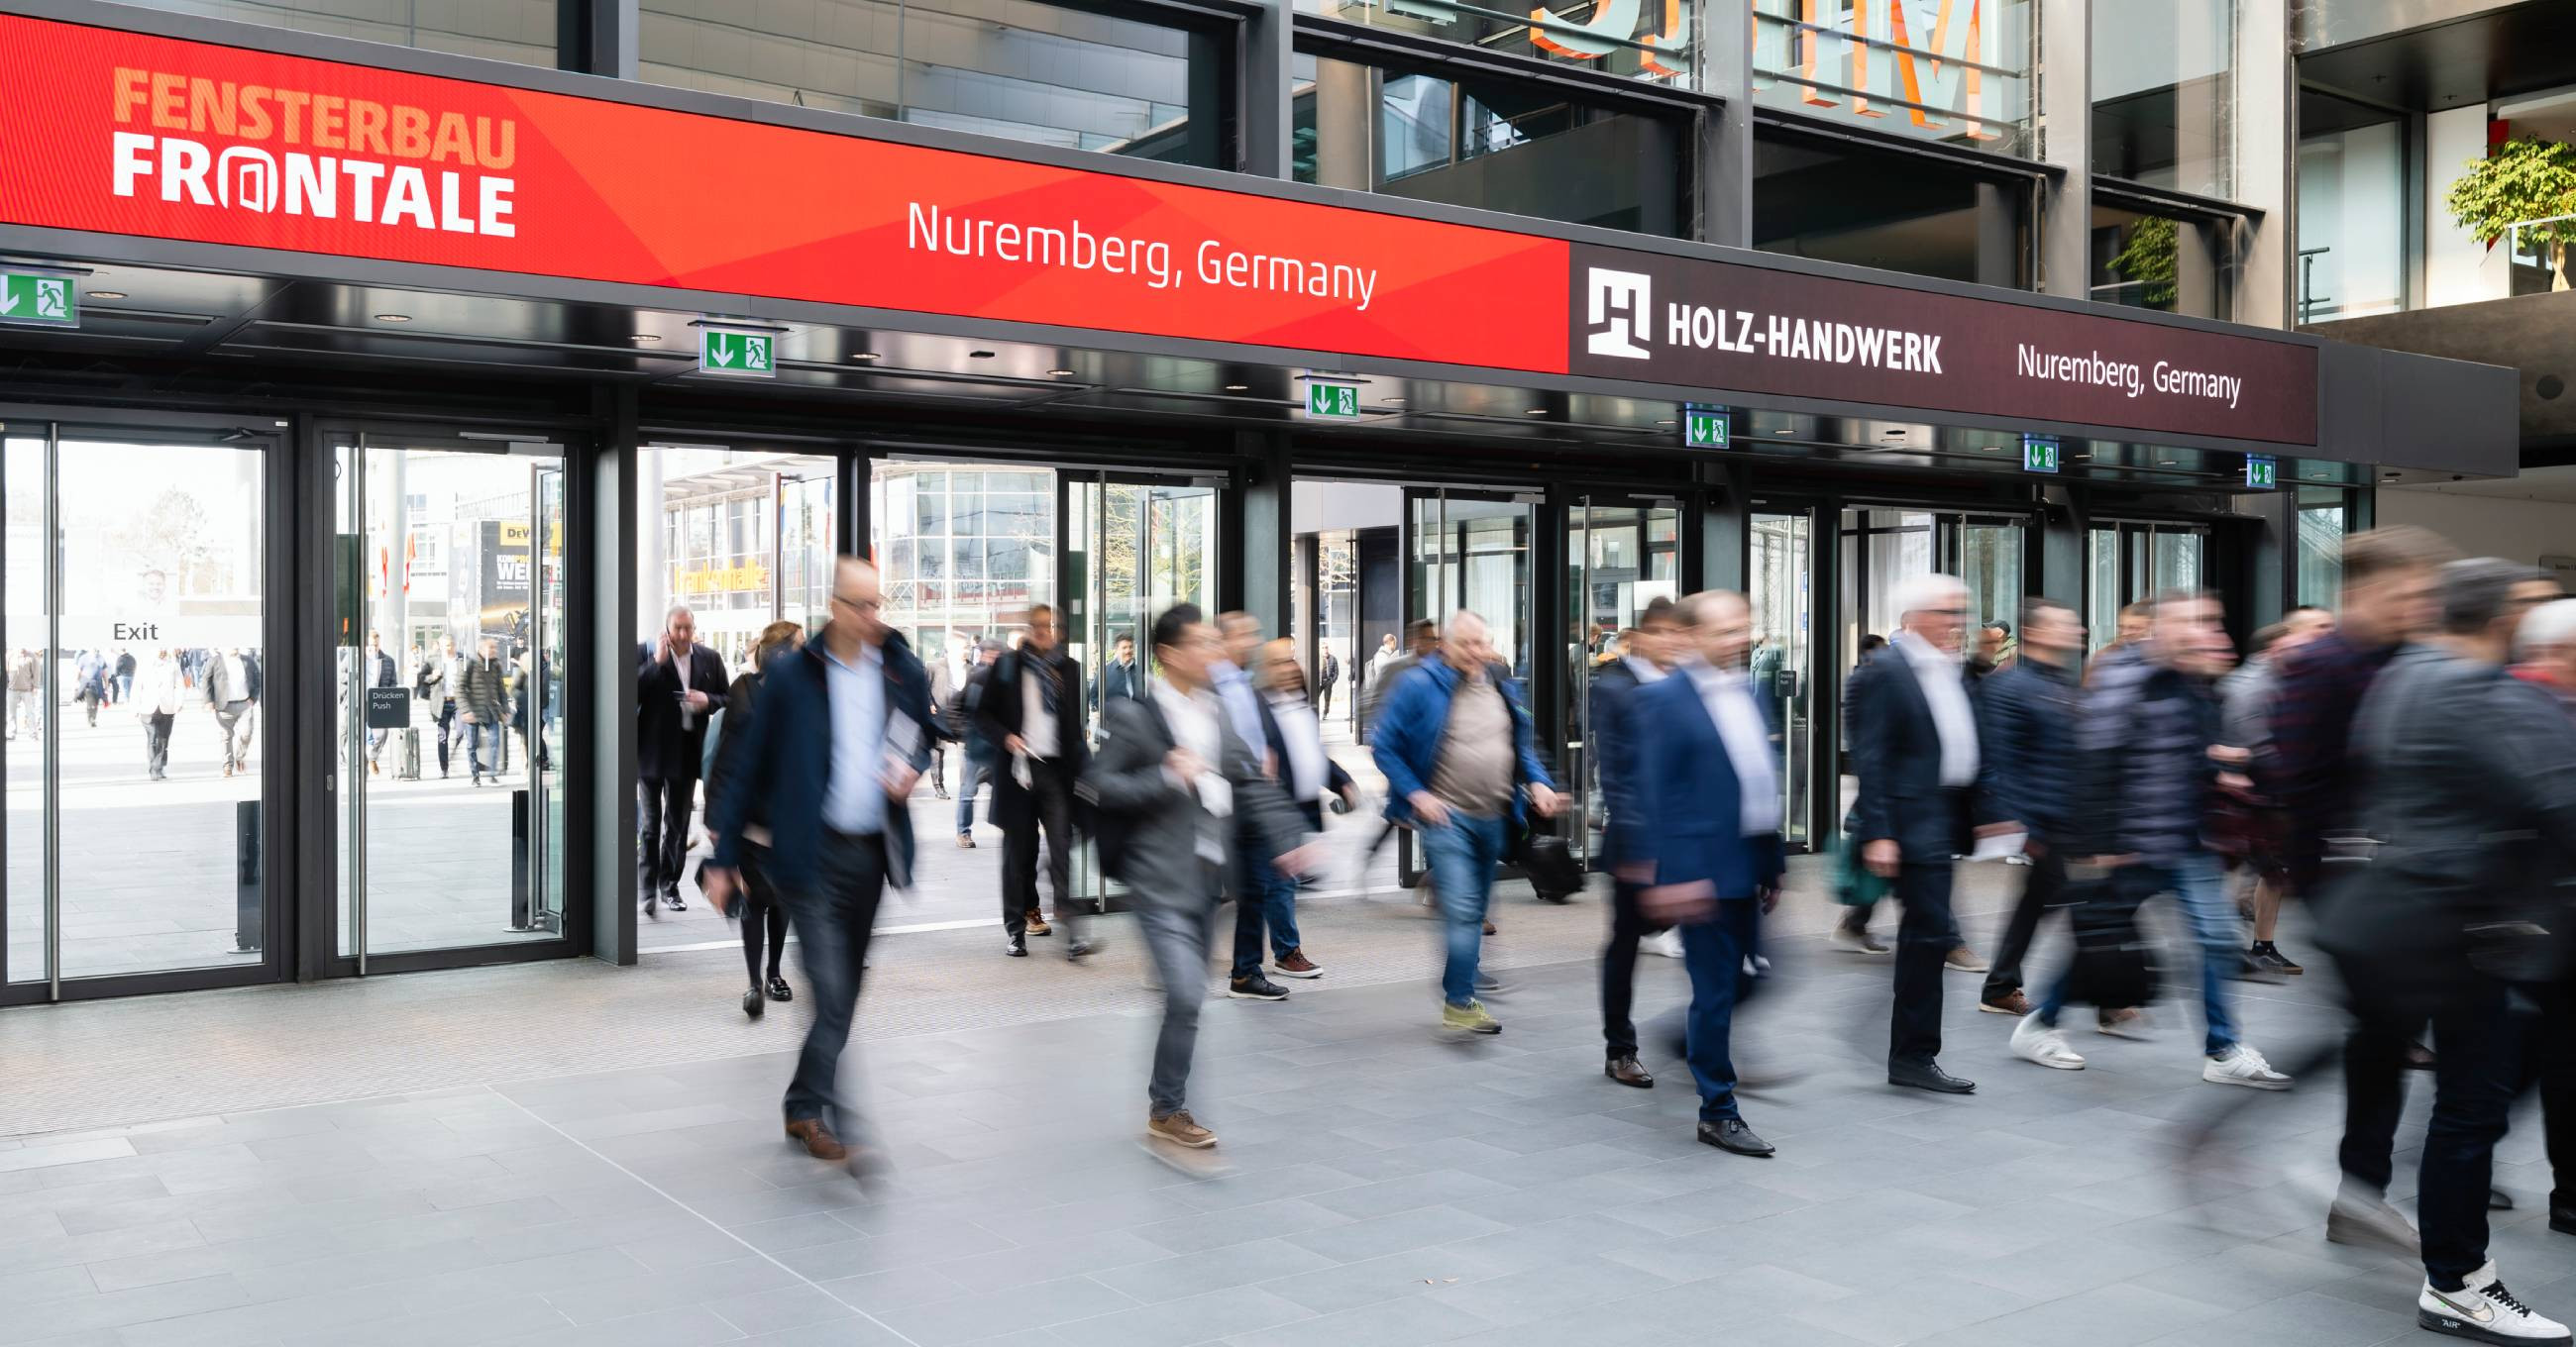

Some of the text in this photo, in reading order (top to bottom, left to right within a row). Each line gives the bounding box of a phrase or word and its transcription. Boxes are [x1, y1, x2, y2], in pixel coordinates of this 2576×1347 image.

[113, 66, 516, 170] FENSTERBAU
[113, 131, 516, 238] FRONTALE
[908, 202, 1377, 310] Nuremberg, Germany
[1667, 302, 1943, 374] HOLZ-HANDWERK
[2017, 343, 2241, 409] Nuremberg, Germany
[114, 622, 159, 641] Exit
